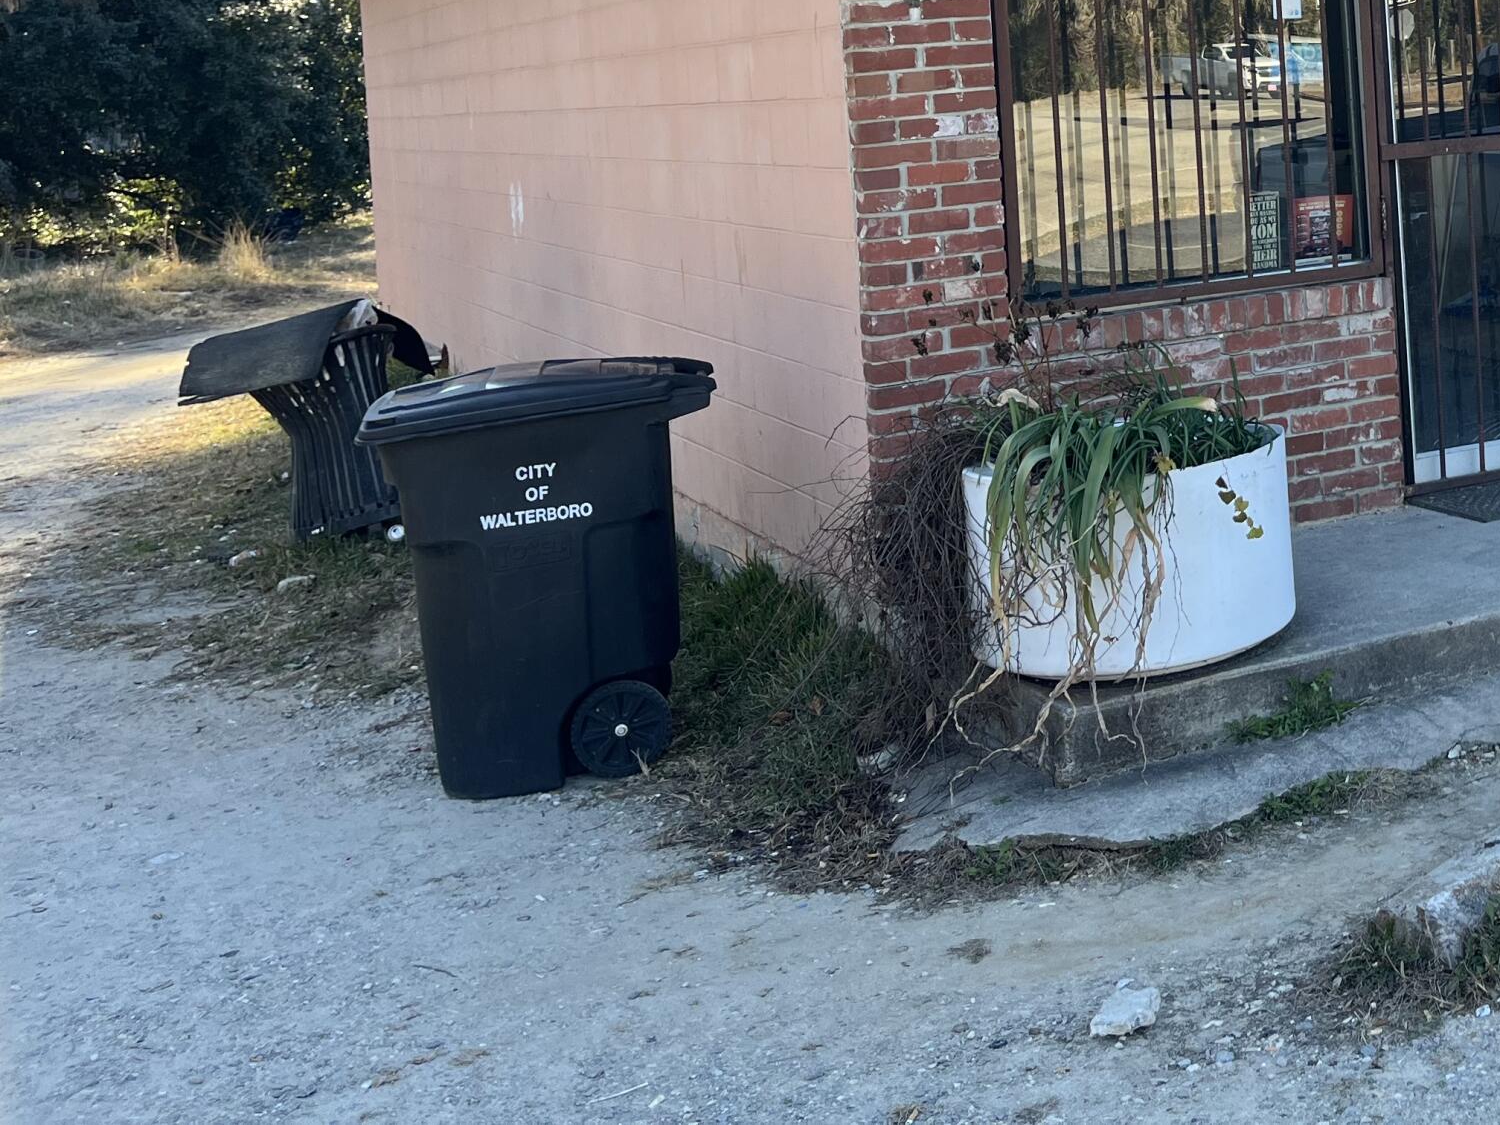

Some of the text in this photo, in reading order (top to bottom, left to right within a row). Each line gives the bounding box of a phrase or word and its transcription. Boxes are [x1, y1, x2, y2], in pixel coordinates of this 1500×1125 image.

[515, 462, 557, 481] CITY
[525, 485, 549, 502] OF
[479, 502, 593, 530] WALTERBORO
